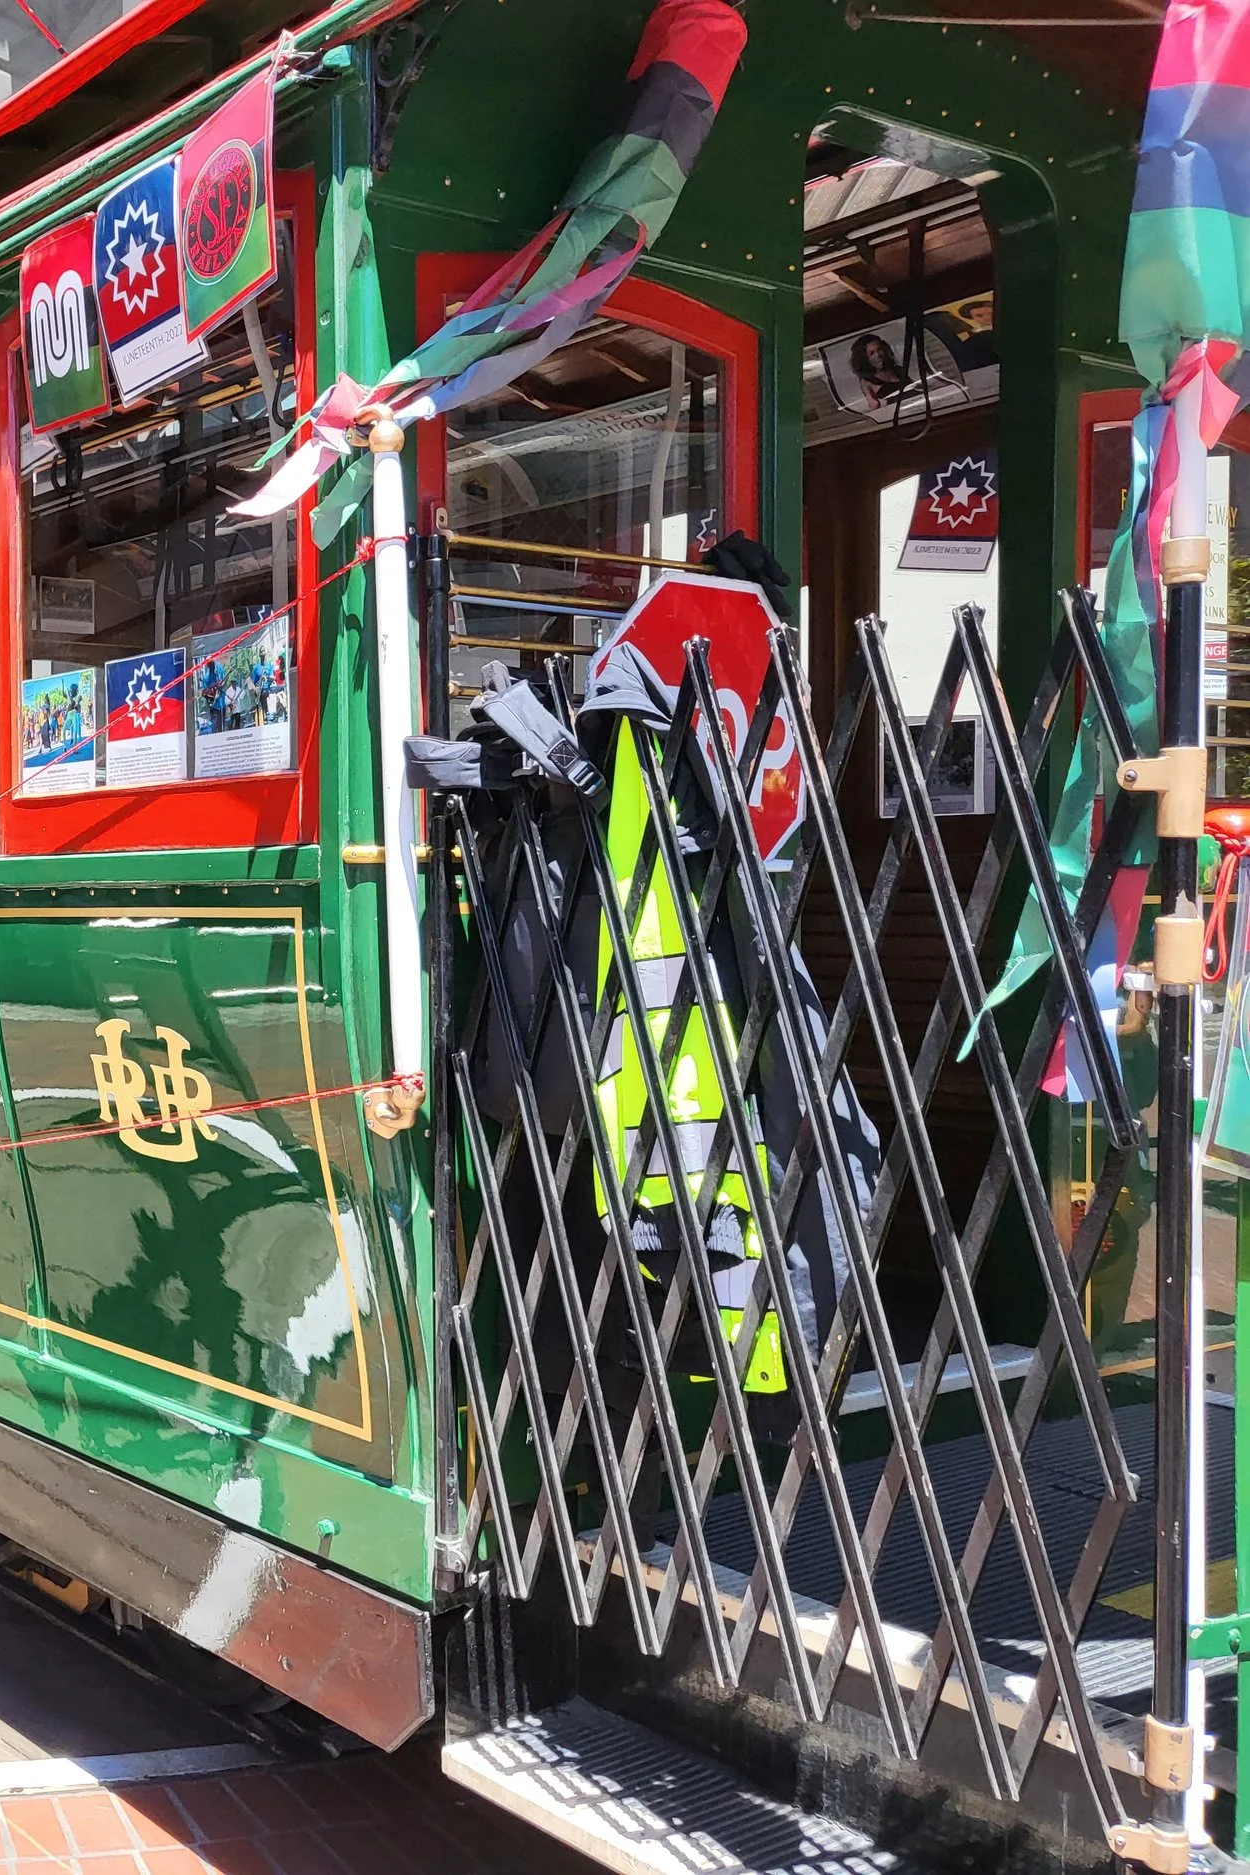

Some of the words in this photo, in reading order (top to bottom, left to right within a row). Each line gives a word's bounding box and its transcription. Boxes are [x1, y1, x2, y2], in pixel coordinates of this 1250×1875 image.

[122, 334, 164, 367] JUNETEENTH
[165, 323, 183, 342] 2022
[913, 545, 960, 555] JUNETEENTH
